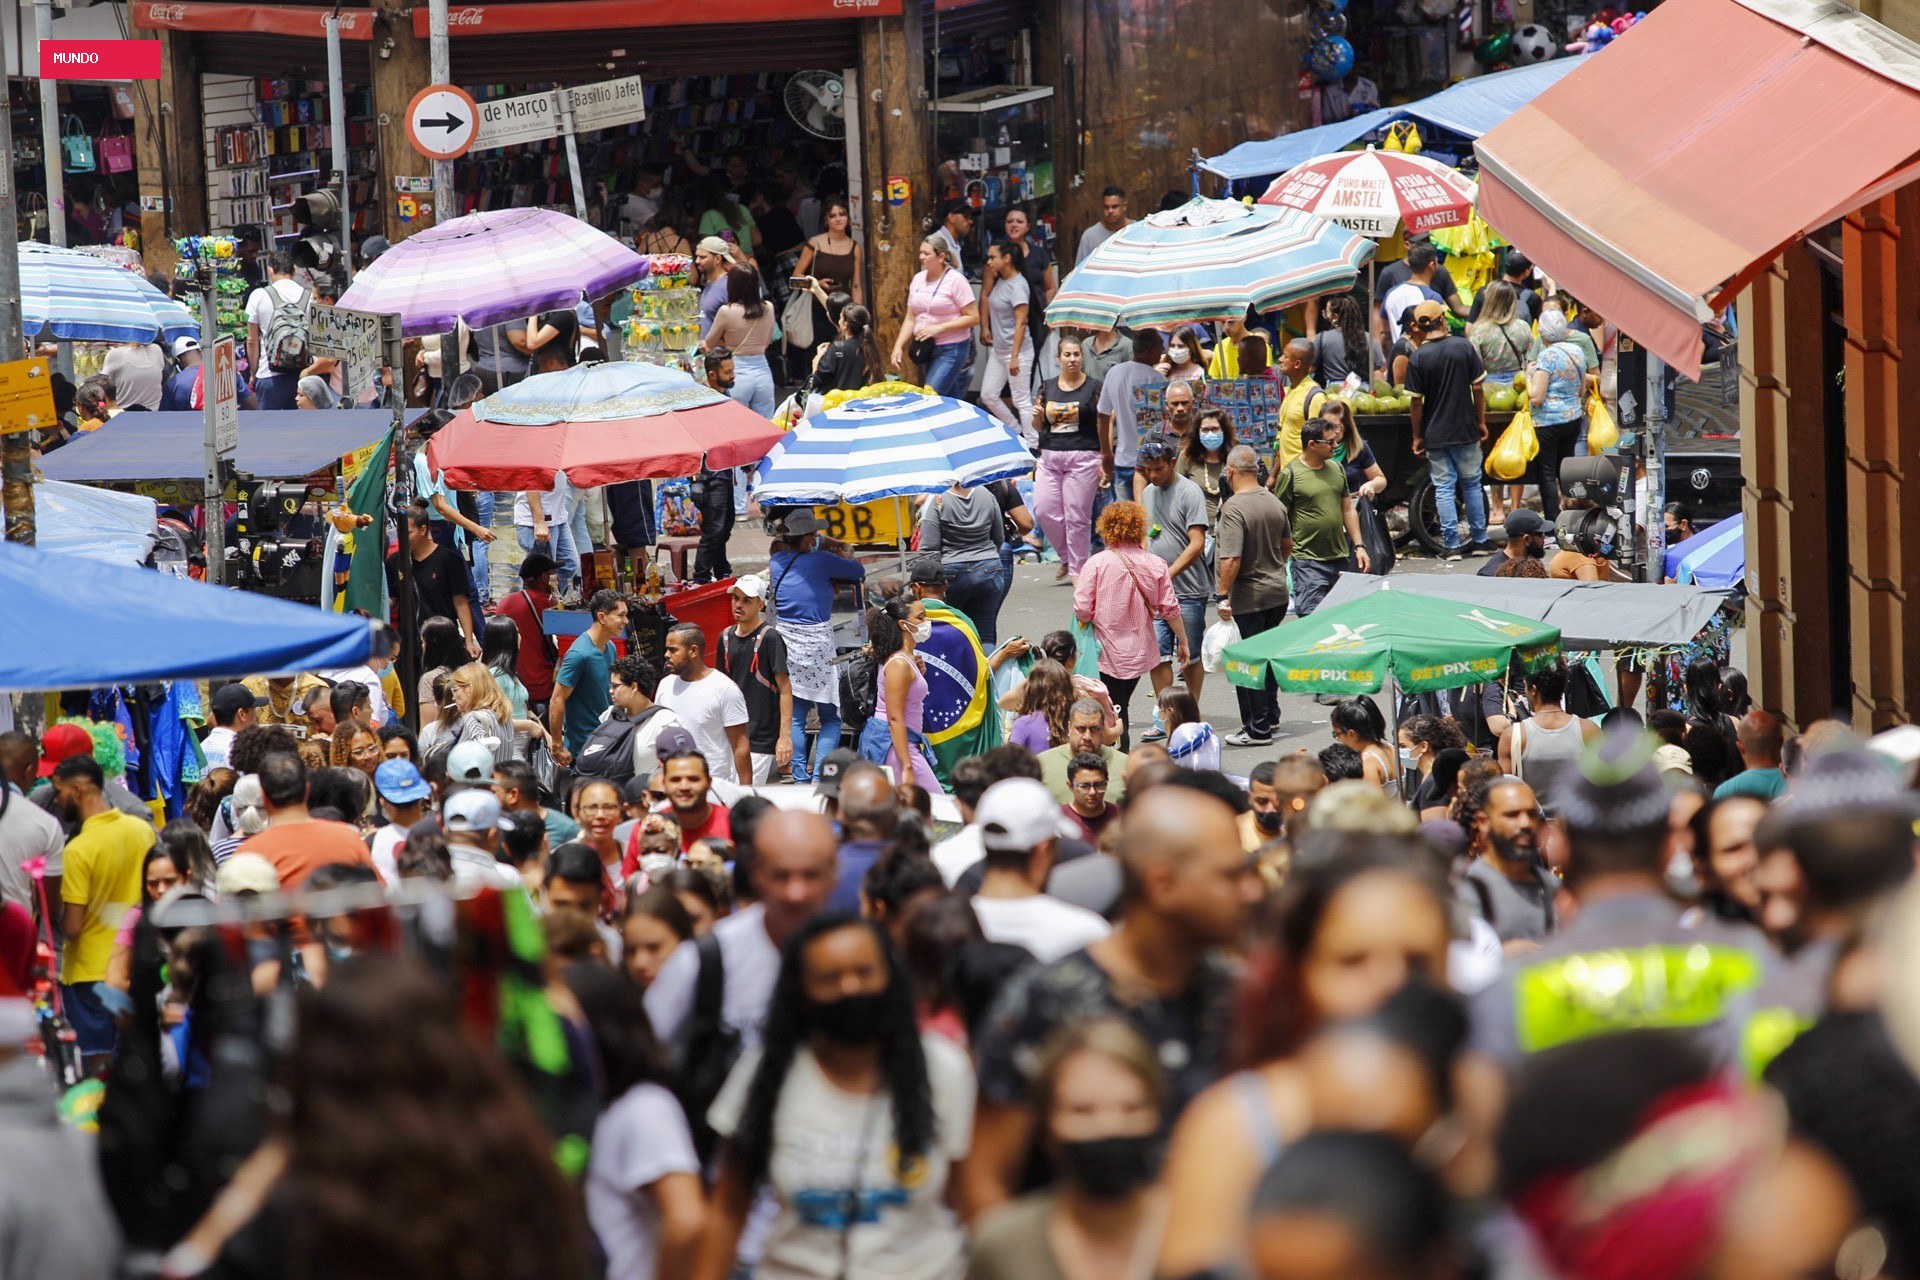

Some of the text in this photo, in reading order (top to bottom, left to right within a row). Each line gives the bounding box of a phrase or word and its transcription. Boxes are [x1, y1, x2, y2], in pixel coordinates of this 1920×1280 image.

[615, 81, 640, 99] Jafet
[484, 98, 547, 122] de Março
[887, 182, 910, 200] 13
[1337, 177, 1386, 190] PURO MALTE
[1332, 190, 1383, 208] AMSTEL
[398, 200, 417, 217] 13
[1415, 209, 1460, 229] AMSTEL
[346, 346, 358, 369] 25
[927, 655, 974, 693] PROGRESSO
[1287, 669, 1374, 683] BETPIX365
[1410, 657, 1497, 681] BETPIX365
